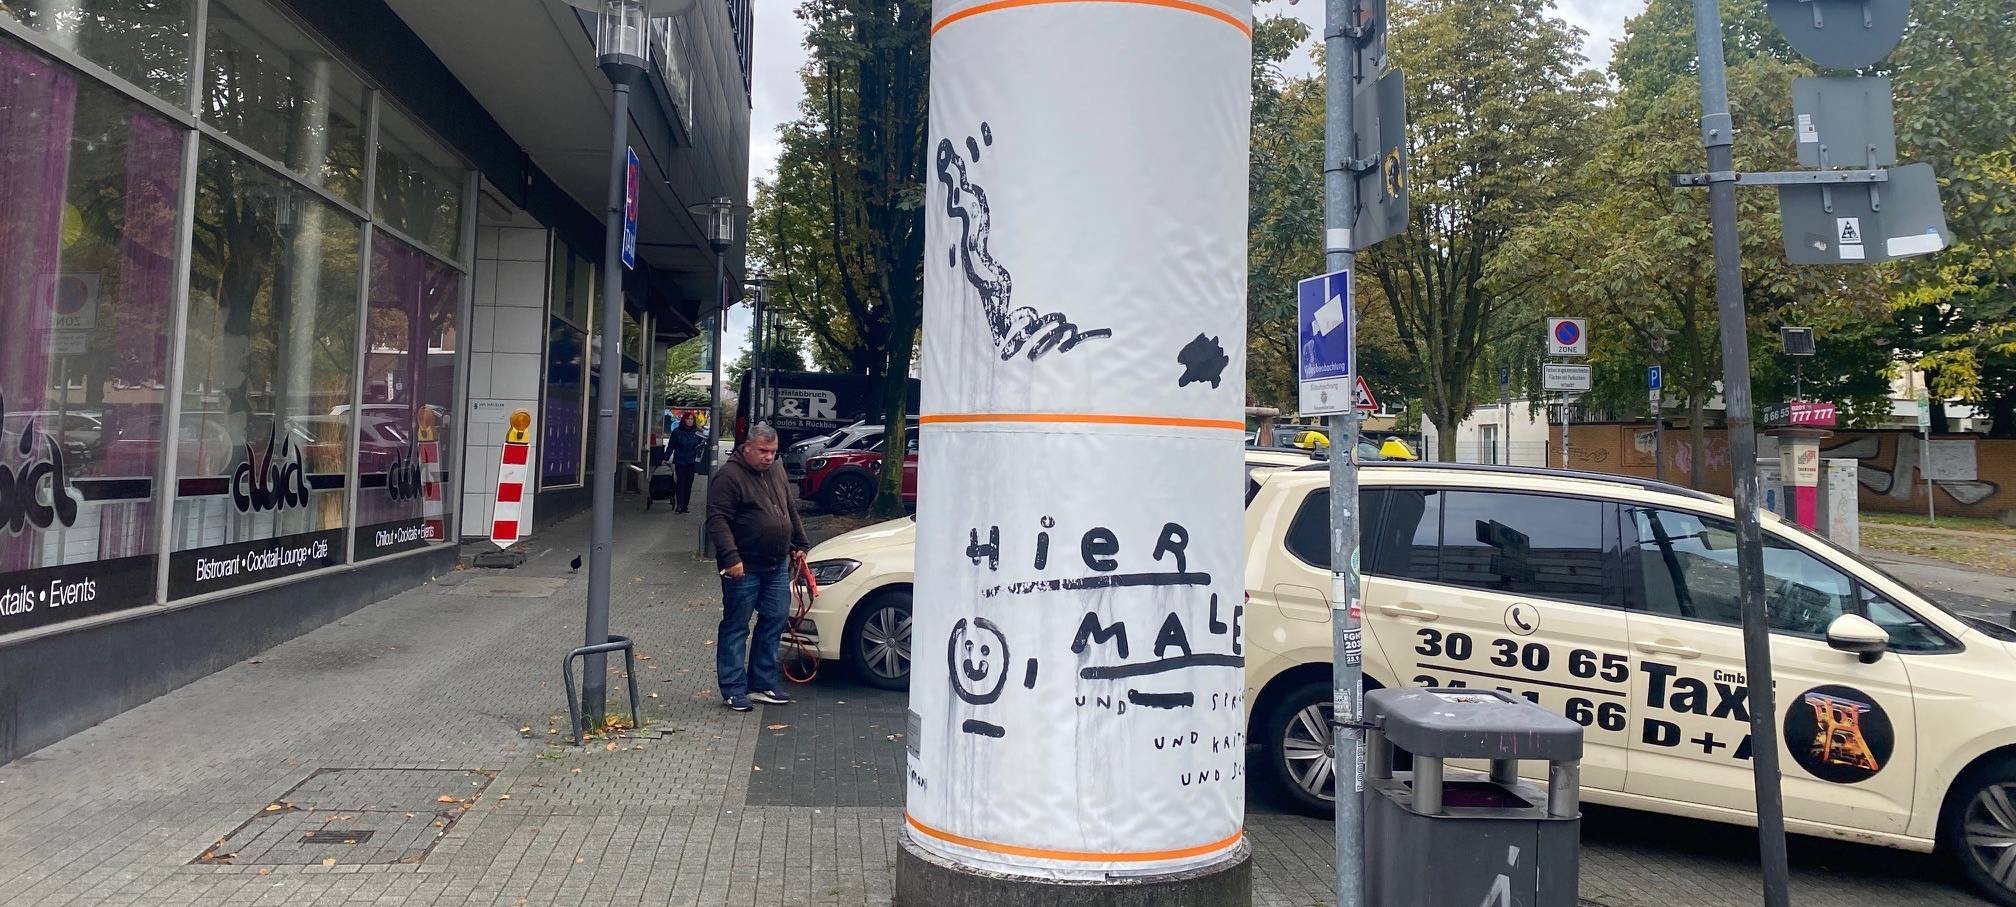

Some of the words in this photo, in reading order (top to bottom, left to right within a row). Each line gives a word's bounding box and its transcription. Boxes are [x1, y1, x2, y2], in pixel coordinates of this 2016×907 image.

[1651, 369, 1658, 386] P
[1792, 410, 1812, 422] 777
[1814, 408, 1834, 420] 777
[375, 529, 395, 547] Chillout
[397, 525, 418, 543] Cocktails
[420, 523, 435, 538] Events
[196, 554, 240, 581] Bistrorant
[246, 546, 307, 572] Cocktail-Lounge
[312, 539, 328, 559] Café
[49, 576, 96, 608] Events
[1415, 628, 1473, 661] 30
[1490, 638, 1550, 672] 30
[1568, 649, 1630, 683] 65
[1713, 669, 1748, 685] Gmb
[1640, 660, 1776, 723] Tax
[1075, 694, 1127, 716] UND
[1565, 697, 1627, 731] 66
[1154, 731, 1199, 750] UND
[1181, 768, 1220, 786] UND
